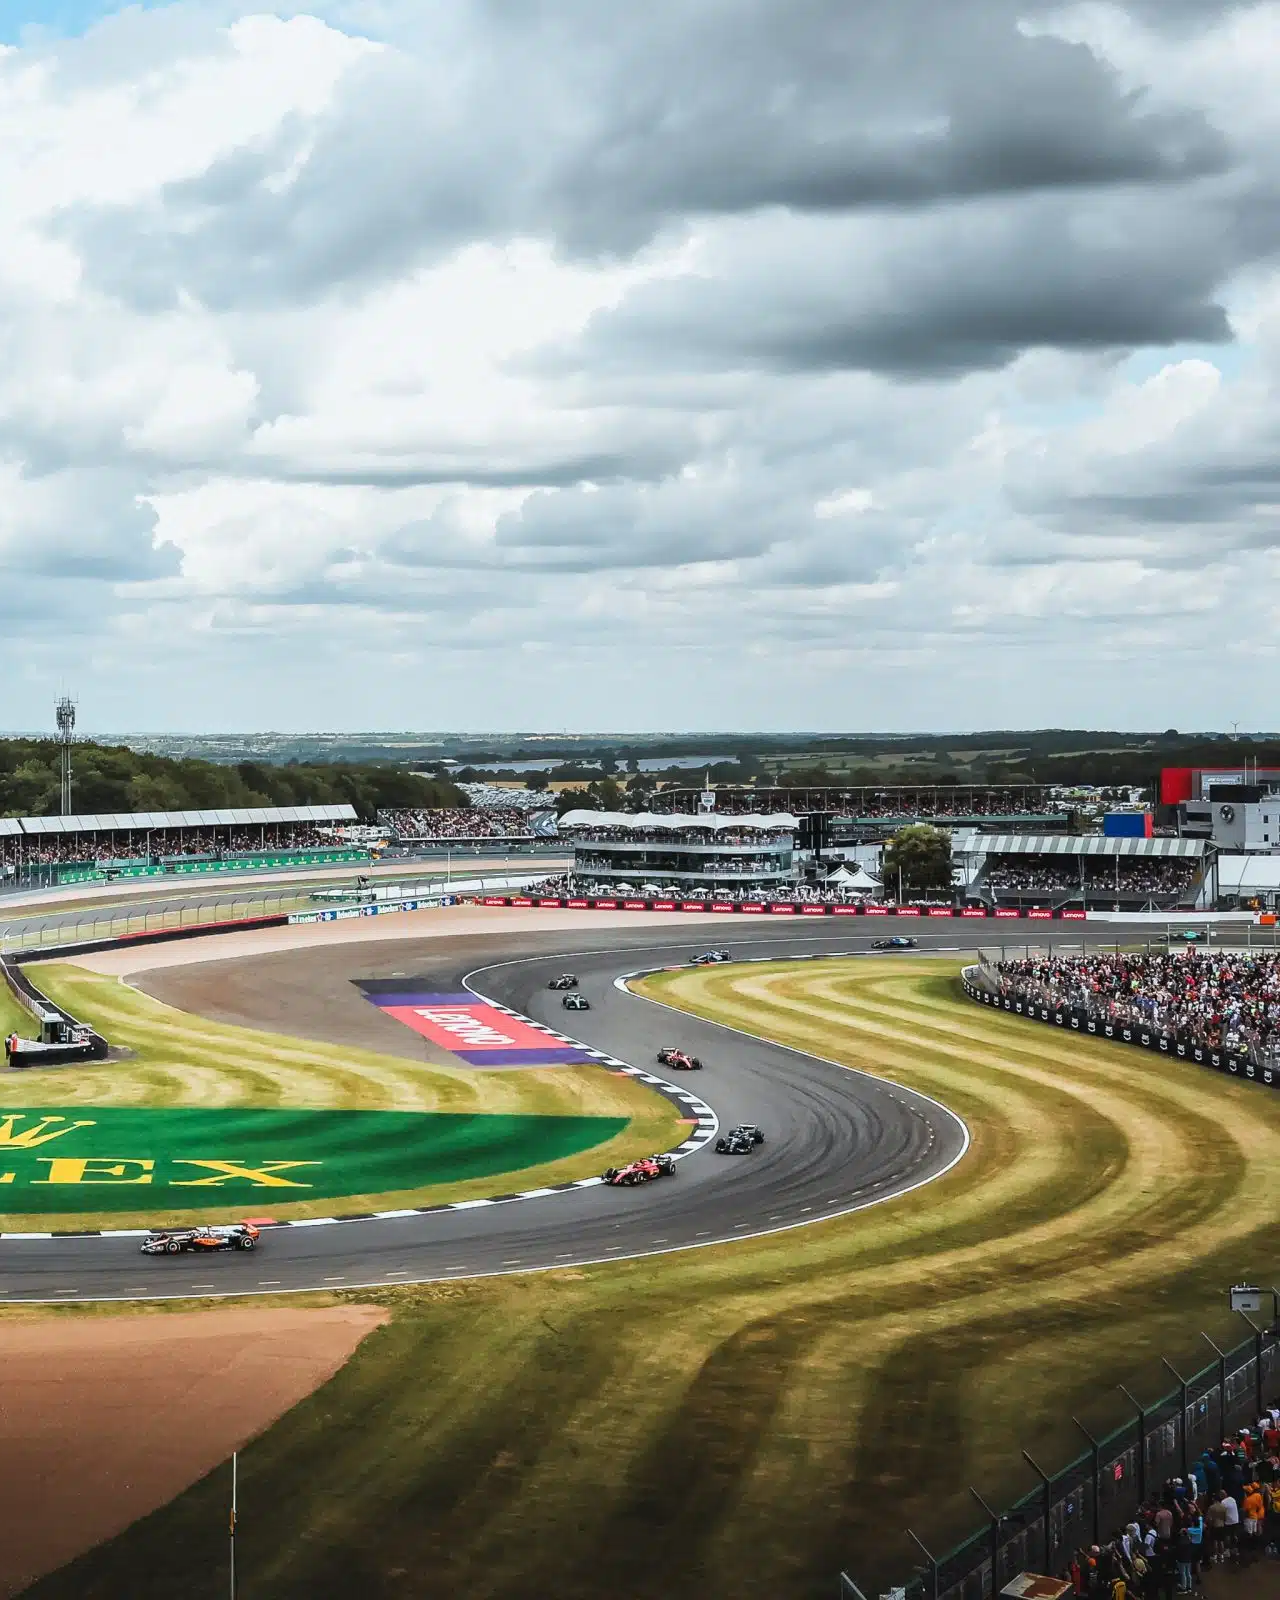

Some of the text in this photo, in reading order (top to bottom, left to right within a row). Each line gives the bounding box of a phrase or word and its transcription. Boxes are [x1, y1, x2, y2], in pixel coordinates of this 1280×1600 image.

[803, 906, 823, 914] Lenovo
[866, 907, 886, 915] Lenovo
[413, 1008, 516, 1045] Lenovo
